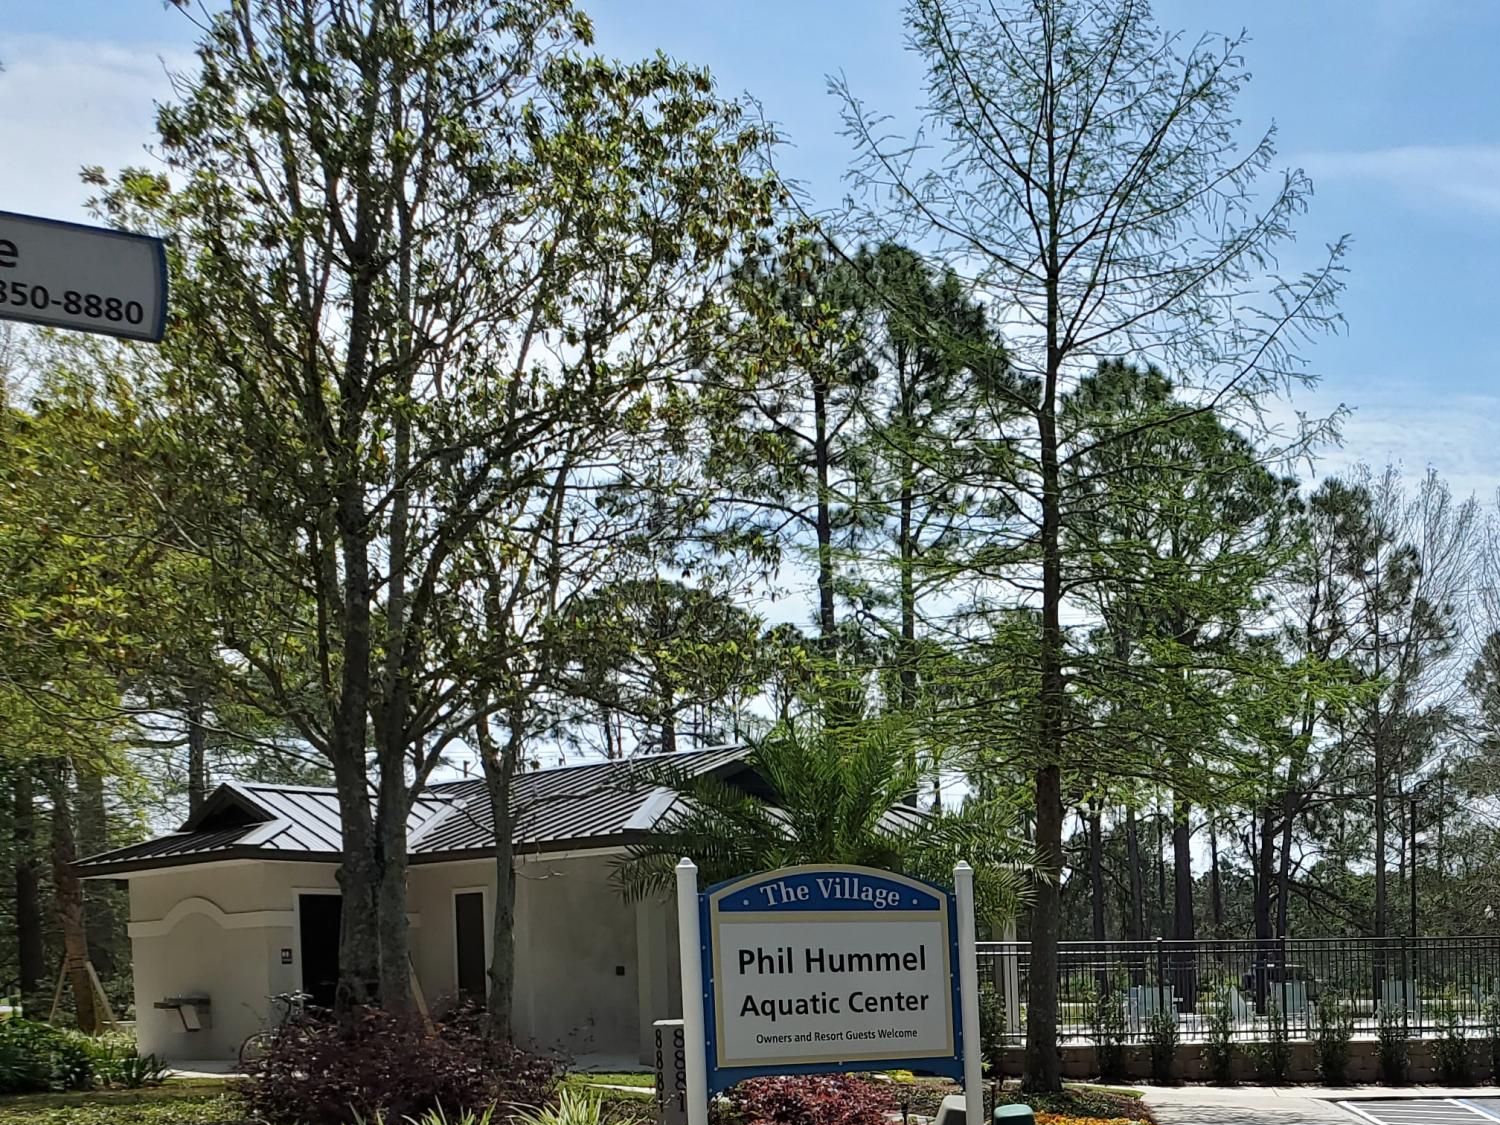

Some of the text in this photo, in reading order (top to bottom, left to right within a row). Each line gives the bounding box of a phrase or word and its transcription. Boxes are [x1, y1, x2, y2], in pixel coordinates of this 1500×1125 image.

[760, 877, 900, 909] The Village
[738, 945, 926, 975] Phil Hummel
[740, 991, 930, 1022] Aquatic Center
[756, 1028, 918, 1044] Owners and Resort Guests Welcome
